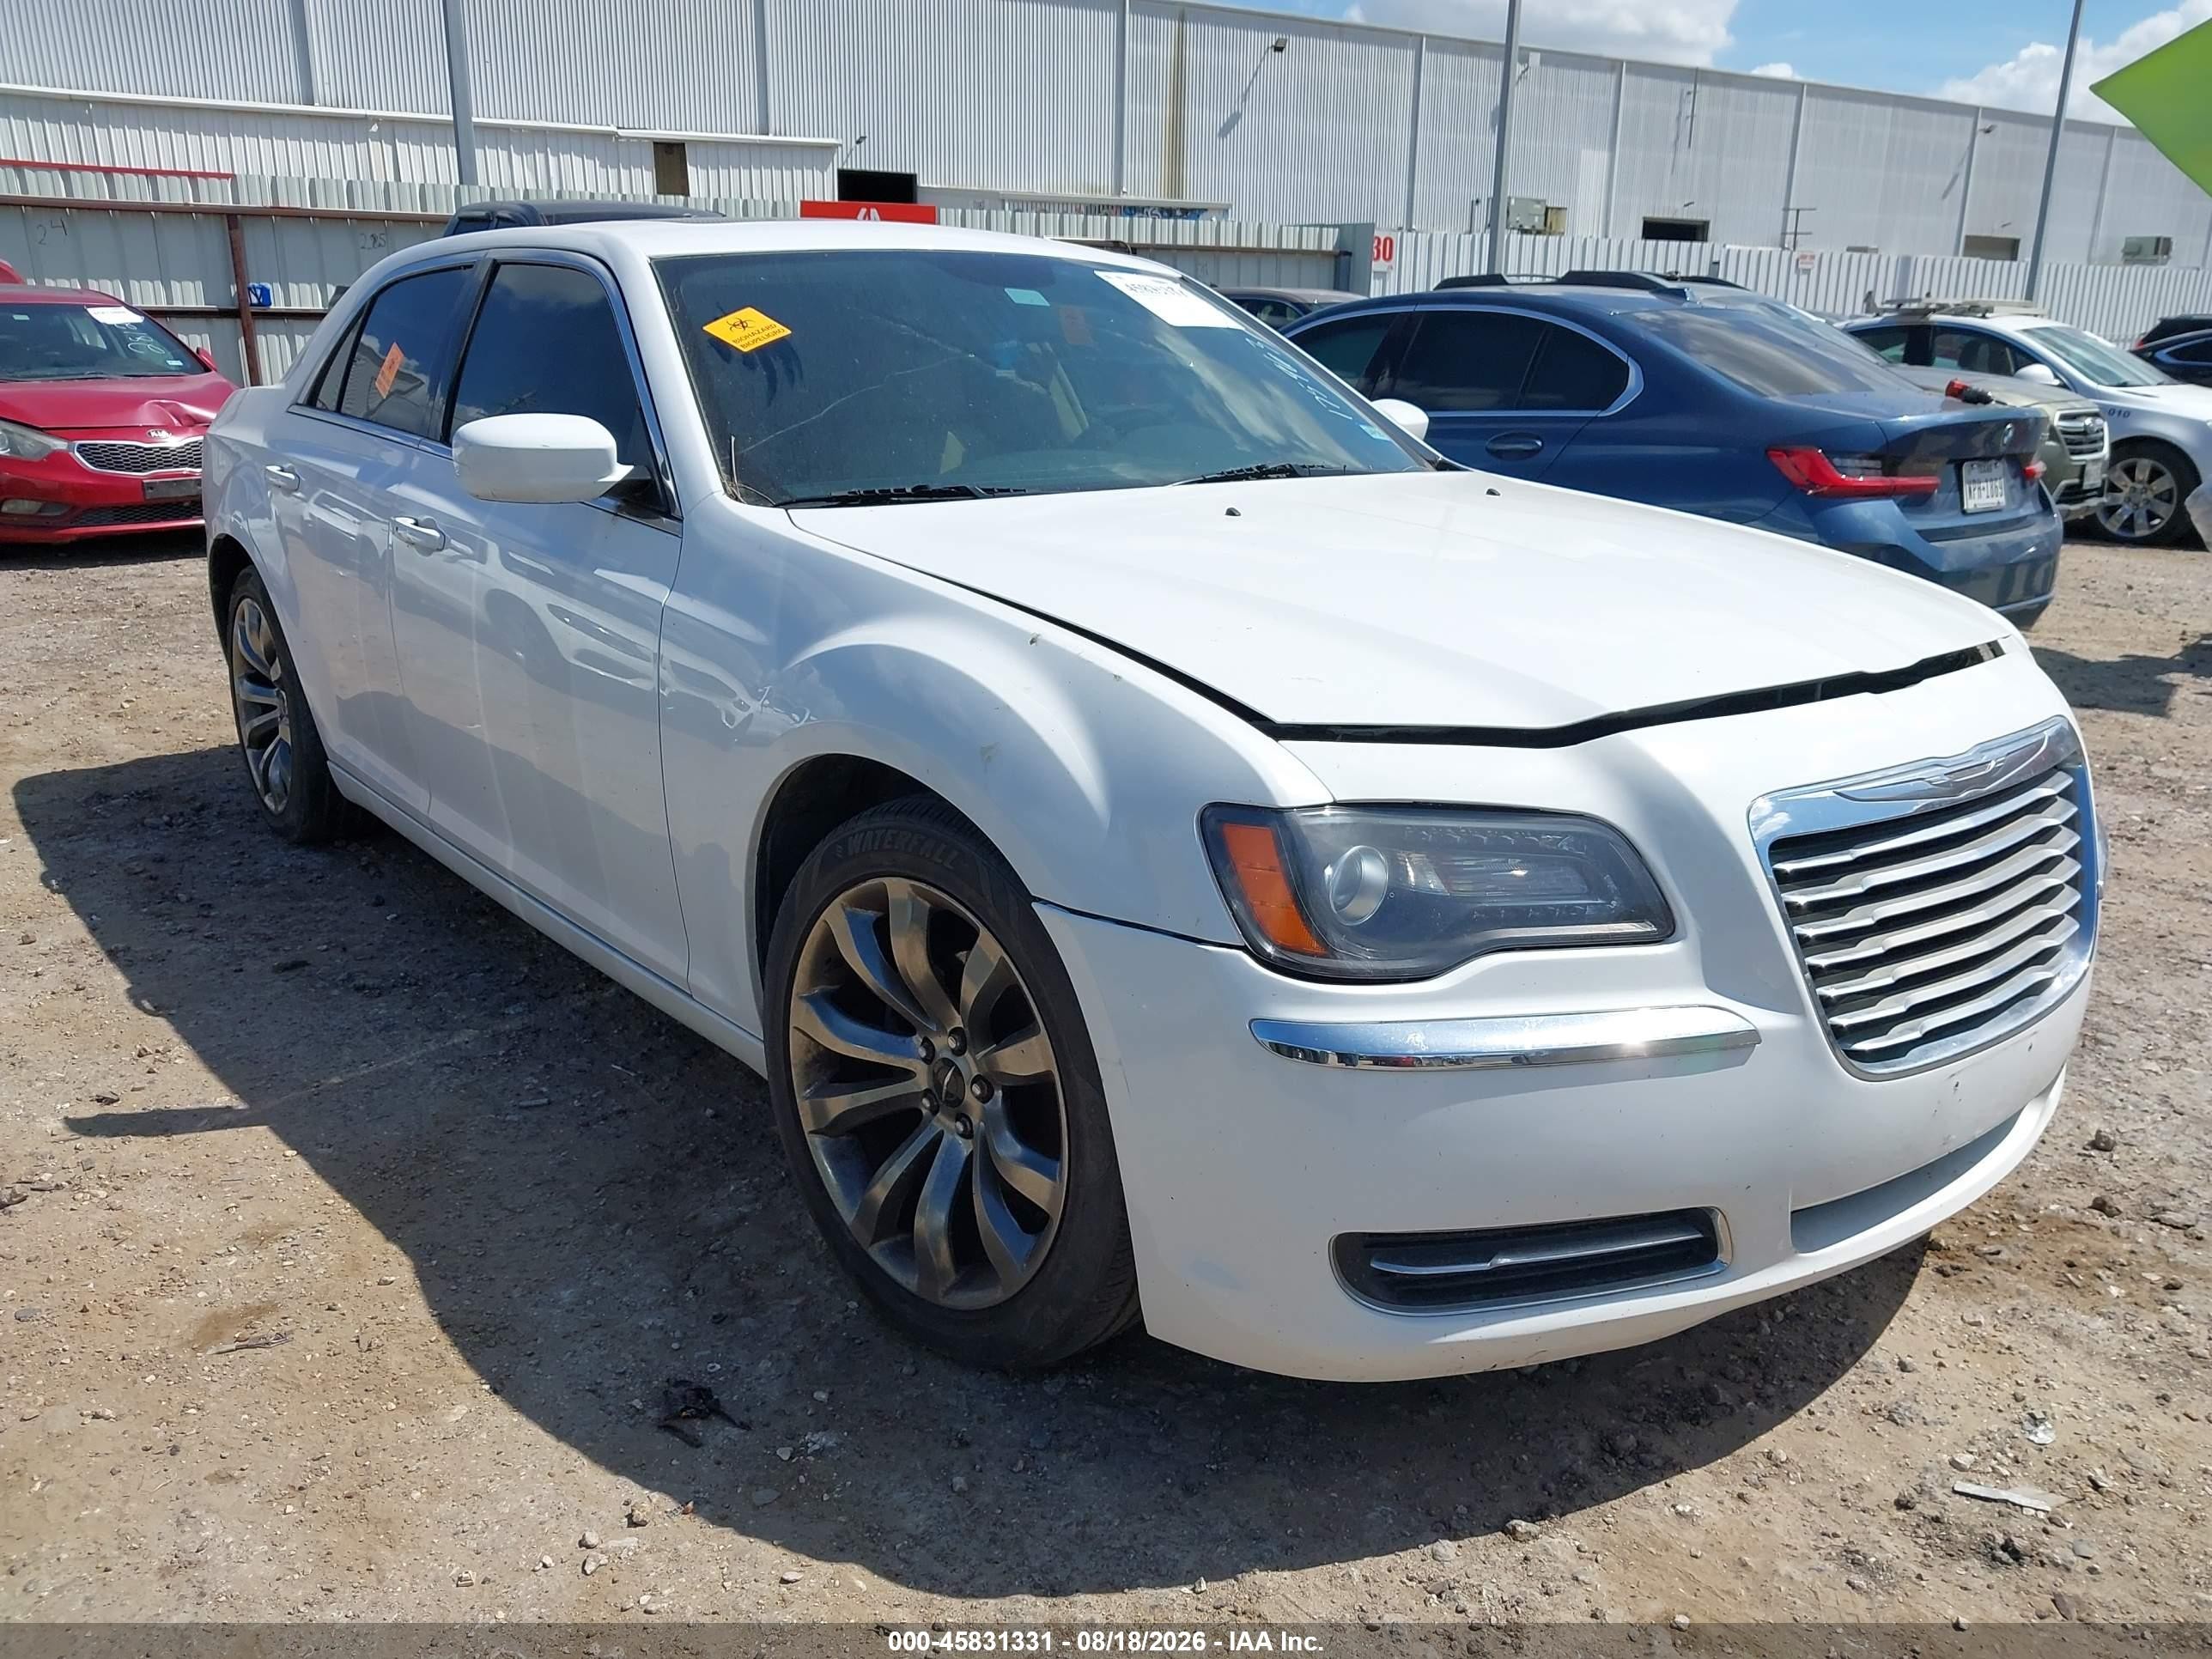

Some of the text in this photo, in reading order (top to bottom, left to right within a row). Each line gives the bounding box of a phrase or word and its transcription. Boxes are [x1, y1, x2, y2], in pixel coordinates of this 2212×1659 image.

[732, 324, 777, 343] BIOHAZARD
[739, 328, 785, 349] BIOPELIGRO
[847, 828, 958, 870] WATERFALL
